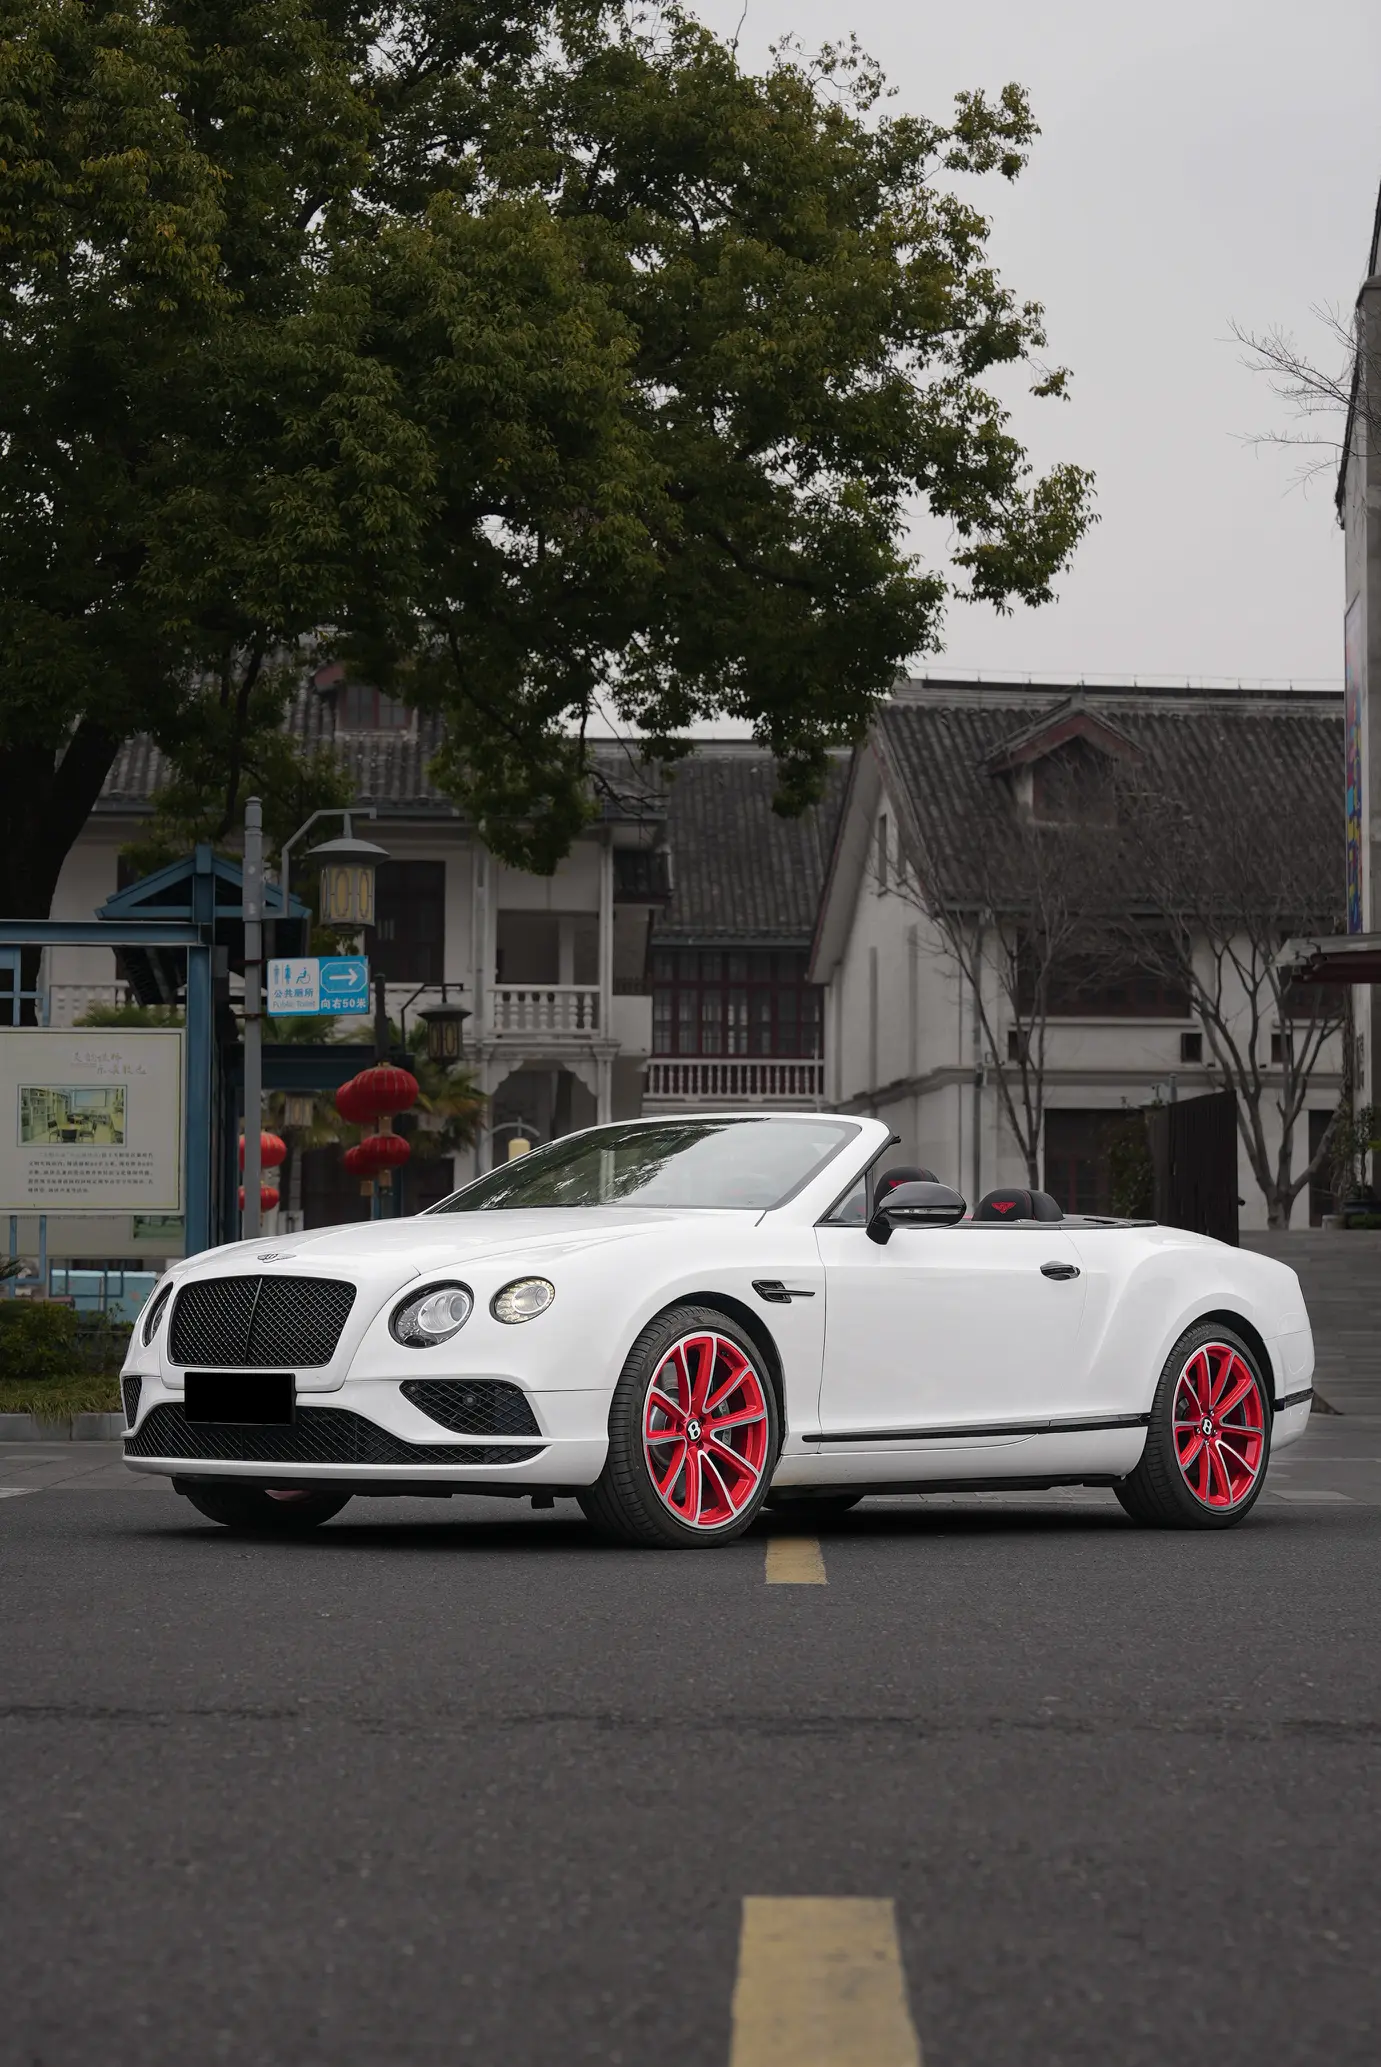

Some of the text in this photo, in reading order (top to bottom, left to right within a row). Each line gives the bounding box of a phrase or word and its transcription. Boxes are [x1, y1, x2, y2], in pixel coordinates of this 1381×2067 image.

[274, 988, 314, 998] 公共厕所
[320, 998, 366, 1009] 向右50米
[688, 1421, 701, 1440] B
[1202, 1418, 1213, 1435] B
